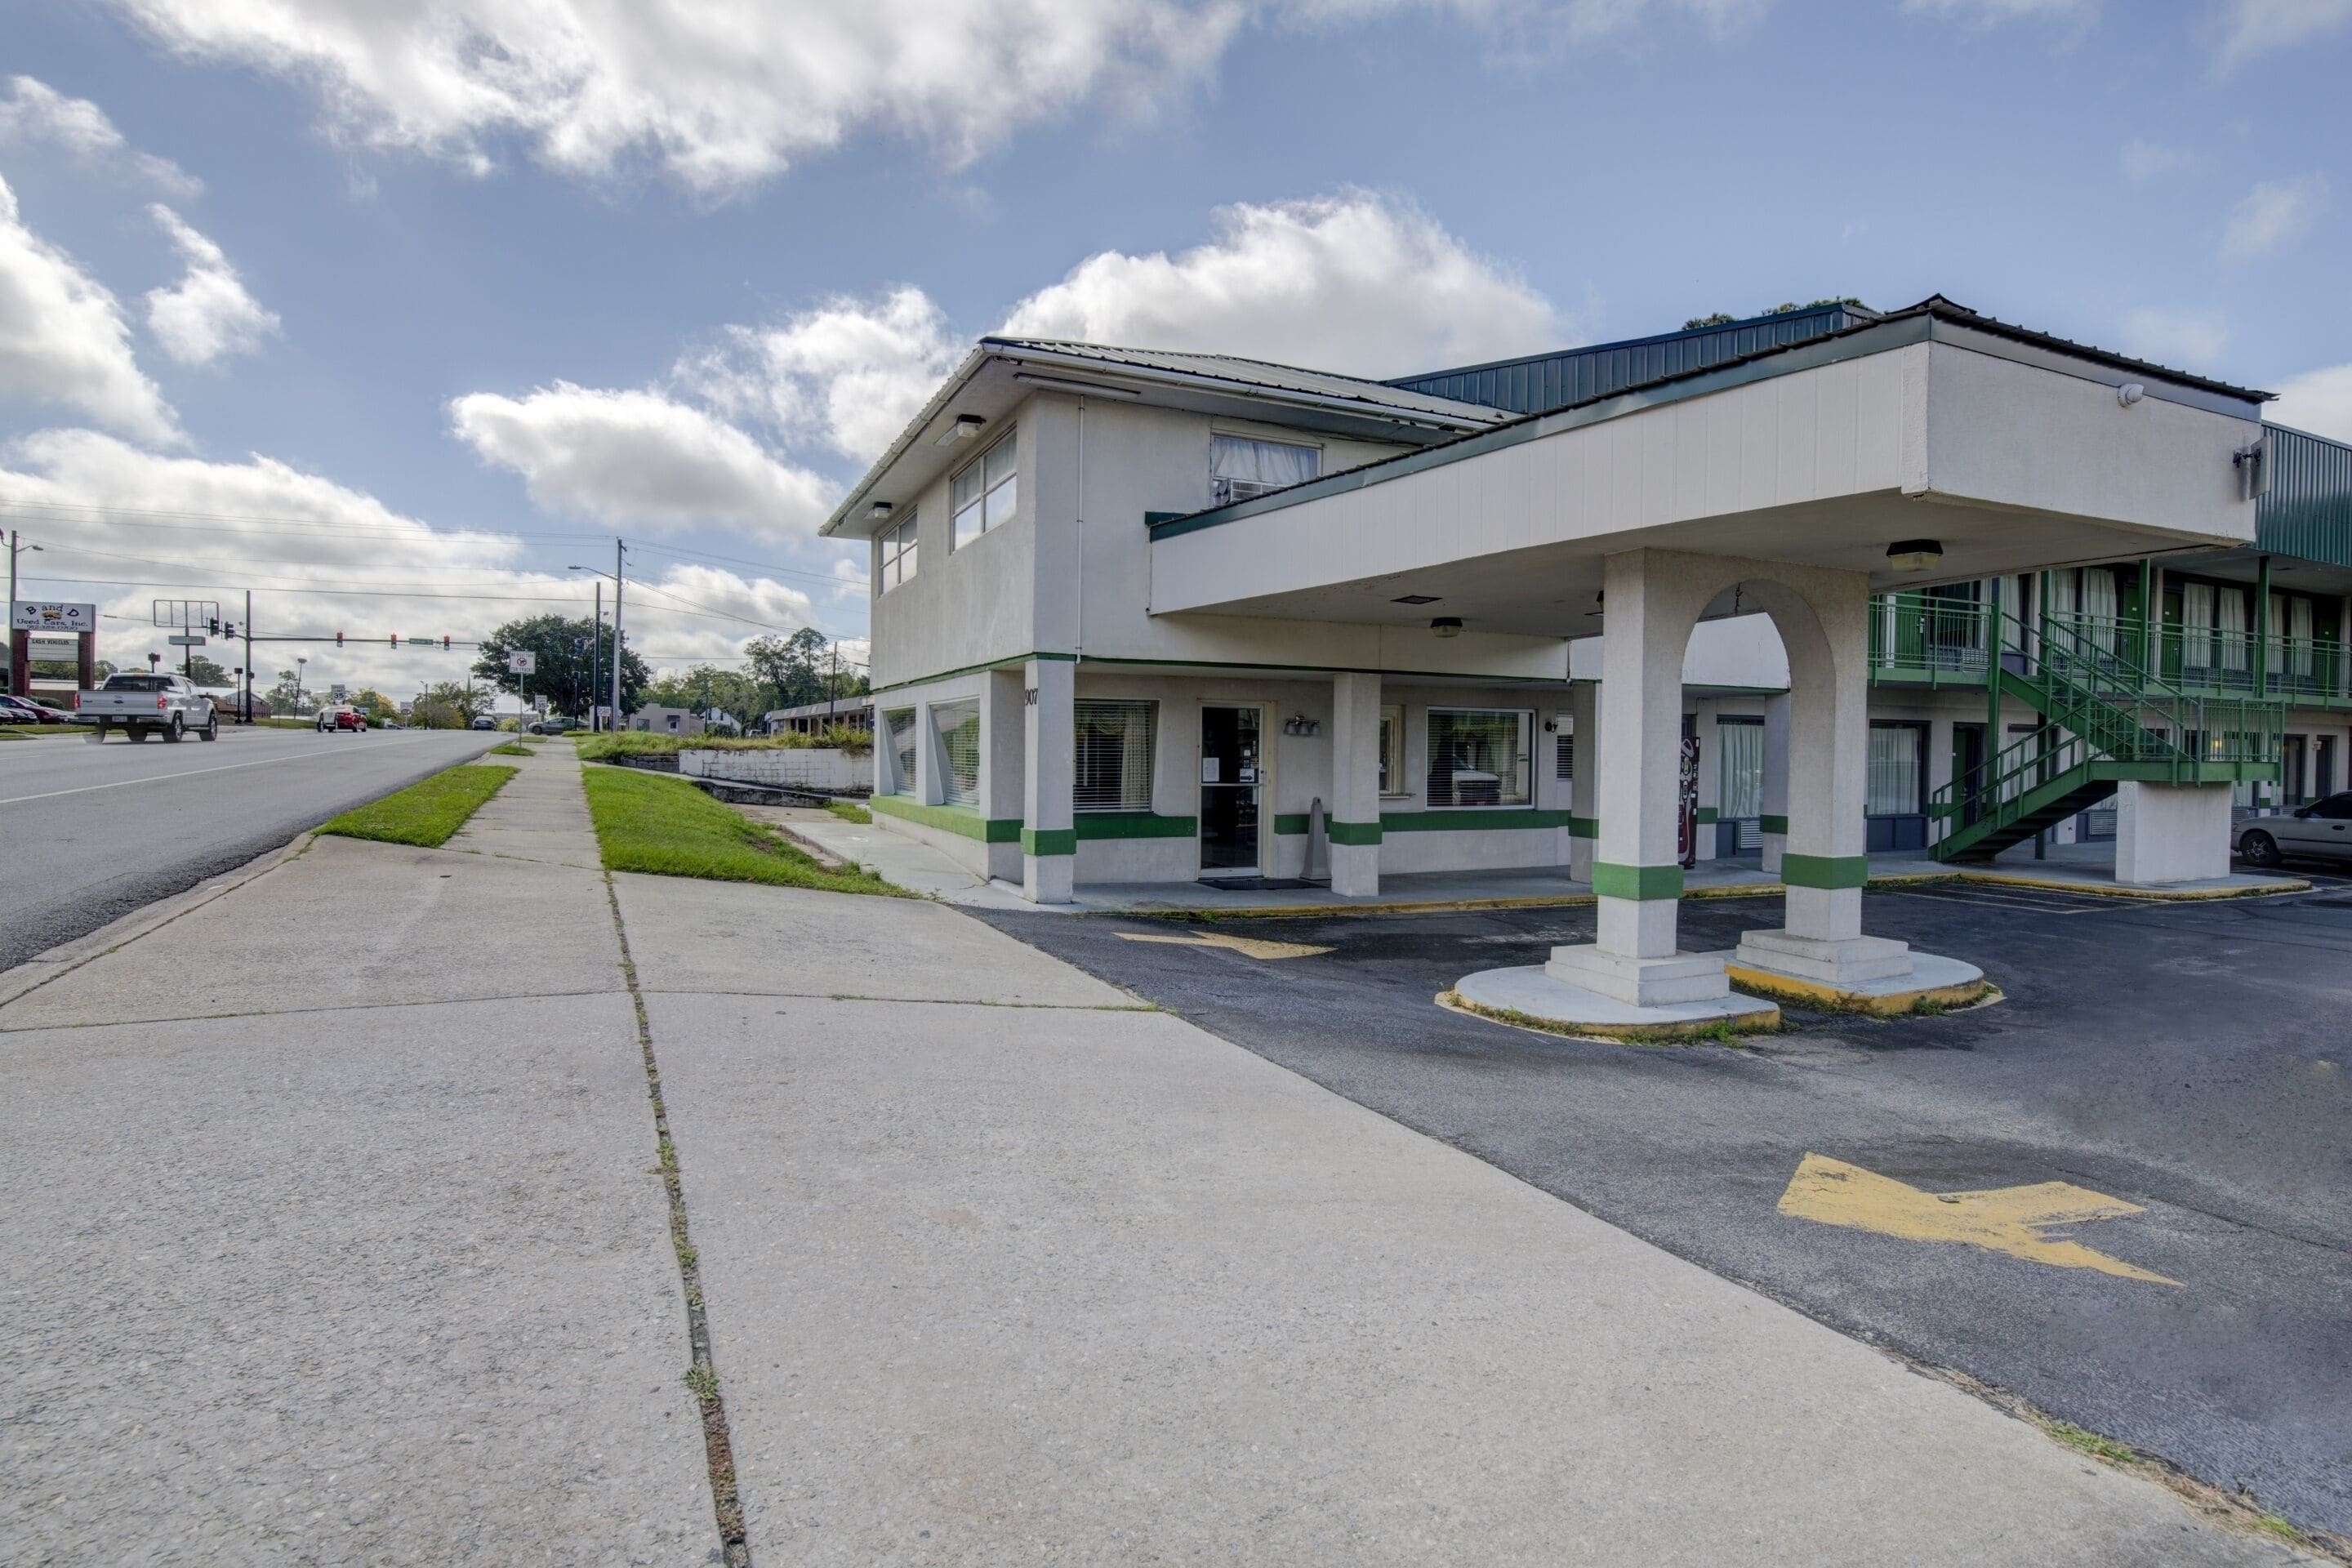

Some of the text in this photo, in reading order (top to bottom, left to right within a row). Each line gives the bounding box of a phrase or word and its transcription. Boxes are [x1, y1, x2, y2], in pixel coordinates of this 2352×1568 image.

[26, 604, 79, 617] B and D
[1025, 688, 1038, 706] 907
